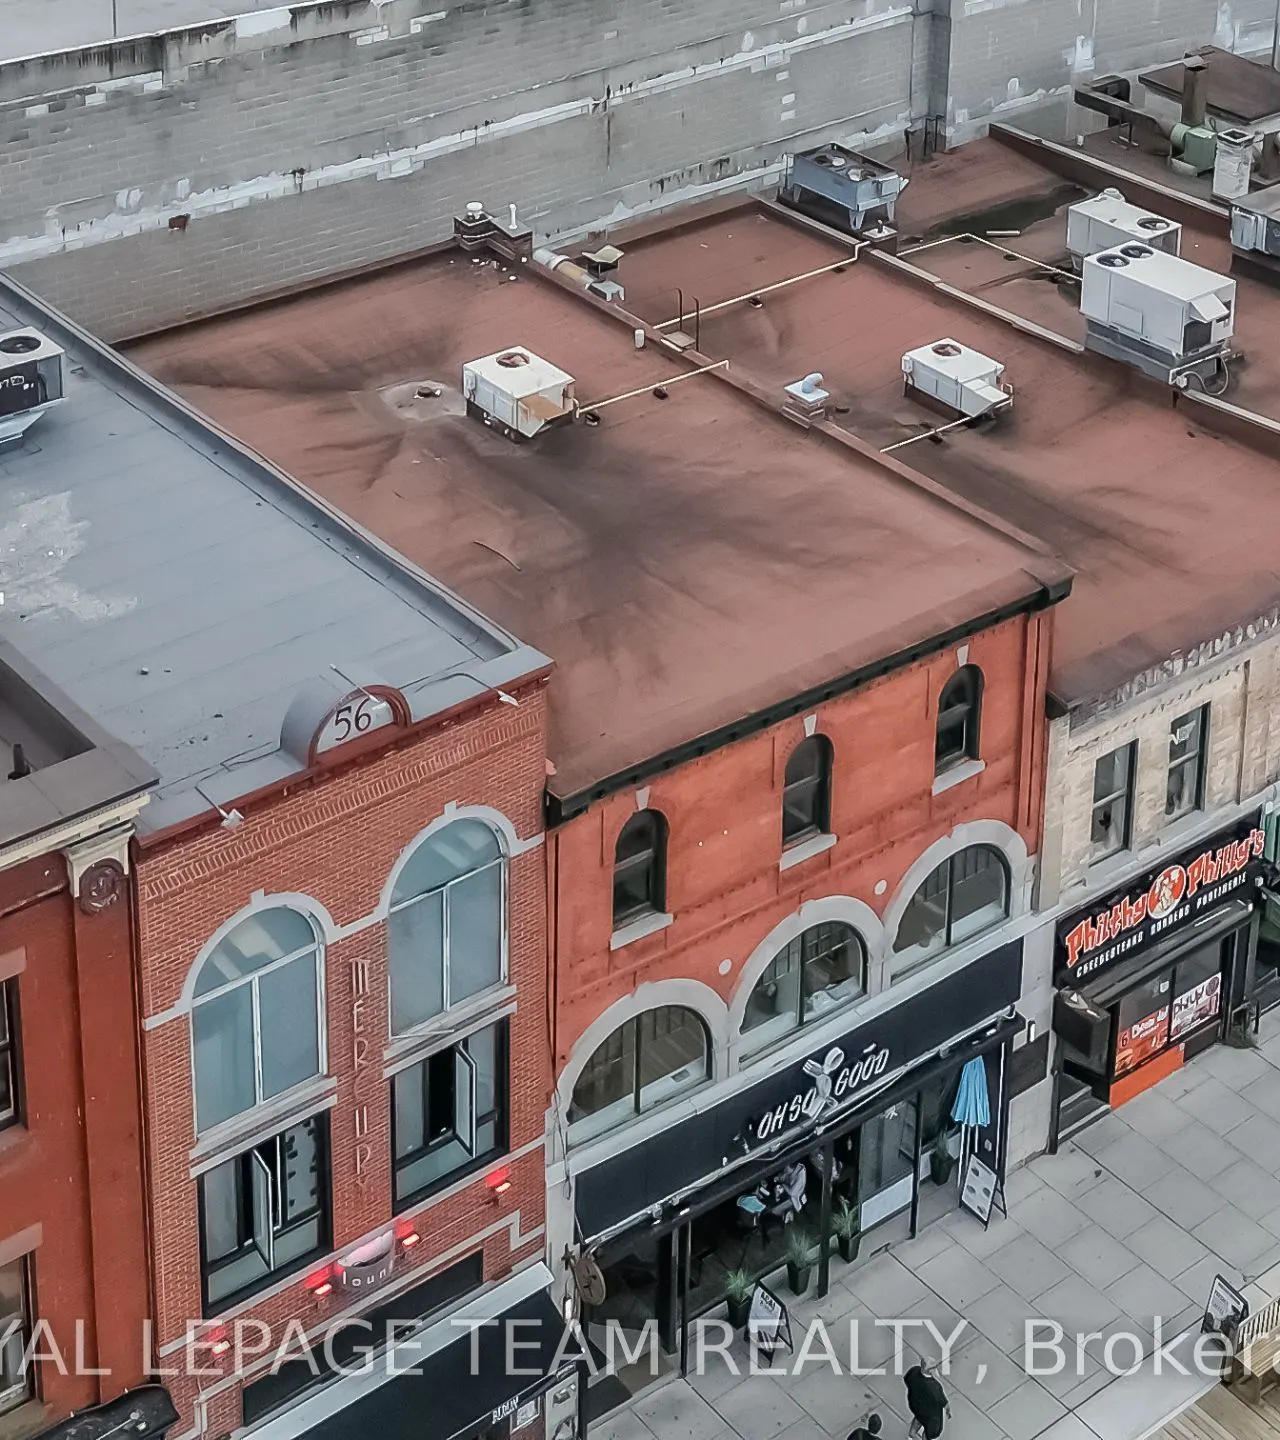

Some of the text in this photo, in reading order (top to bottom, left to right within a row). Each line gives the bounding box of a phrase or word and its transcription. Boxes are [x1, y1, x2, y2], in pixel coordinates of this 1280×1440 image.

[334, 697, 371, 741] 56
[1066, 828, 1265, 968] Philthy Philly's
[349, 957, 372, 1196] MERCURY
[757, 1101, 789, 1140] OH
[789, 1087, 817, 1123] SO
[342, 1267, 388, 1288] loun
